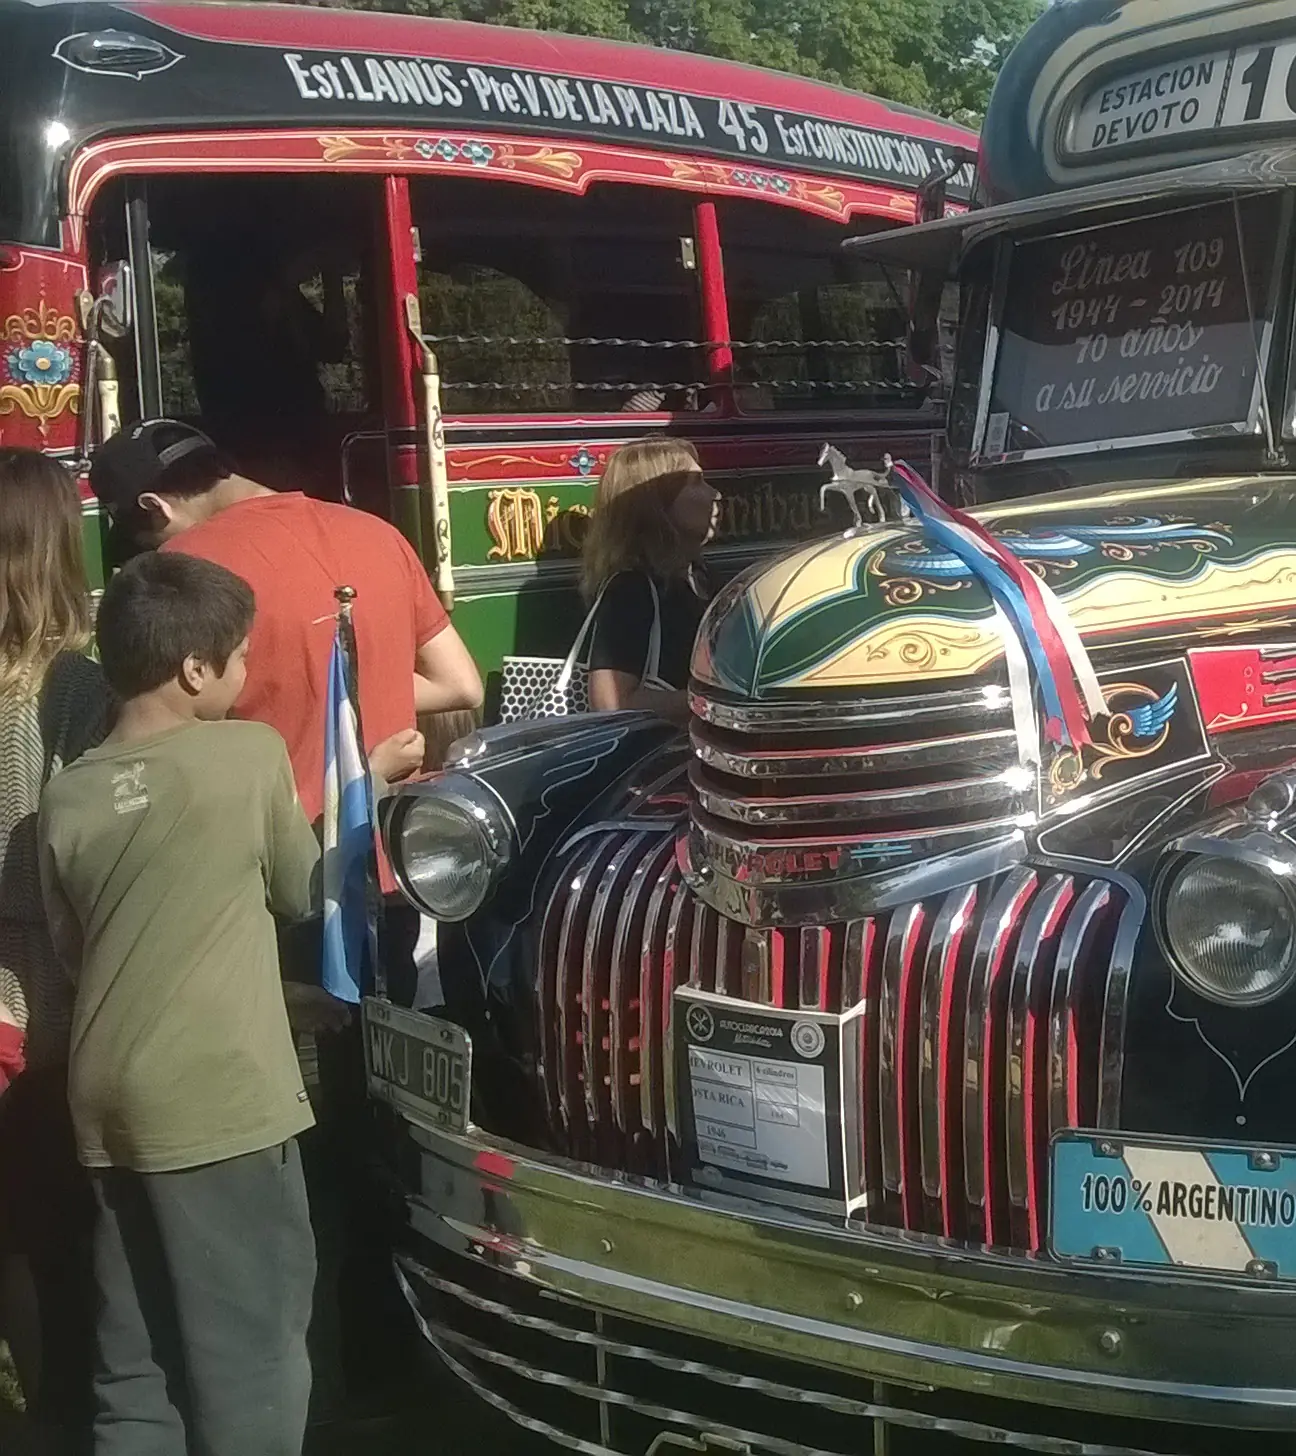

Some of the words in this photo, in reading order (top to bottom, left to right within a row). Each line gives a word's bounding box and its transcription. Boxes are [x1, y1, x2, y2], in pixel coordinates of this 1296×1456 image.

[1099, 60, 1214, 114] ESTACION
[615, 85, 706, 139] PLAZA
[717, 99, 769, 154] 45
[1092, 97, 1201, 148] DEVOTO
[1174, 238, 1224, 274] 109
[1158, 278, 1226, 314] 2014
[1120, 316, 1204, 358] años
[1036, 383, 1052, 412] a
[1055, 377, 1097, 411] su
[1098, 354, 1224, 404] servicio
[423, 1046, 464, 1110] 805
